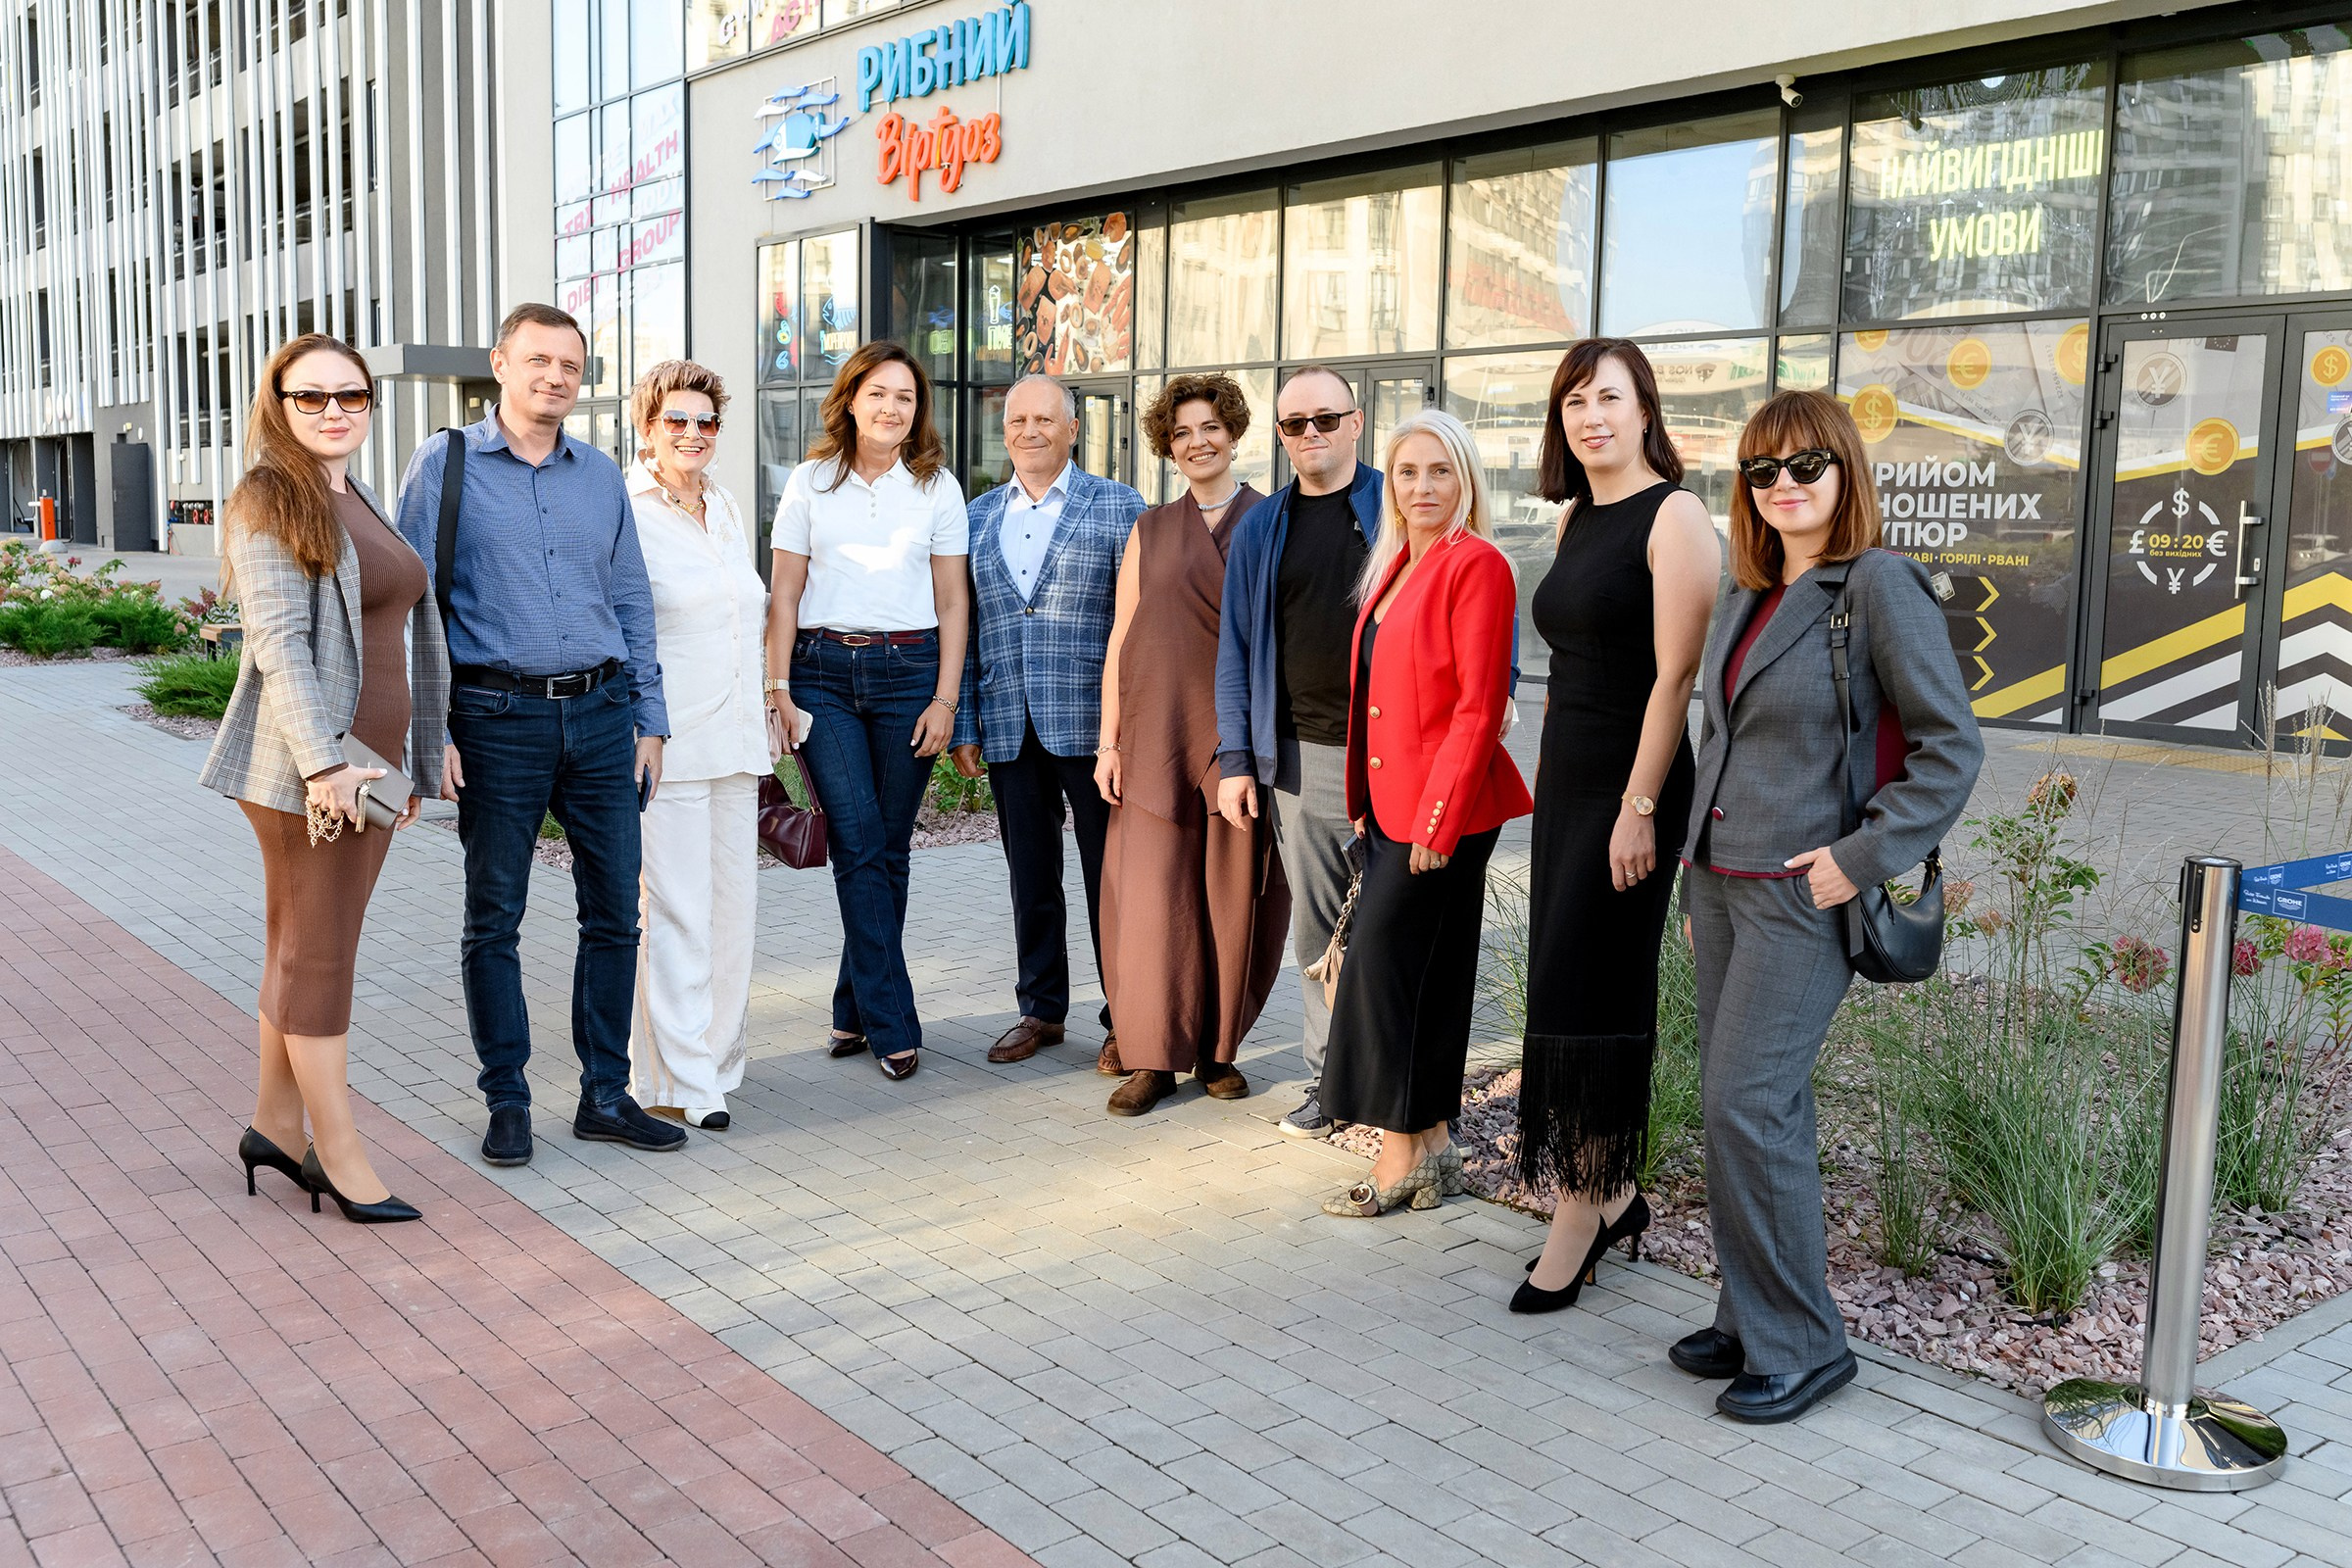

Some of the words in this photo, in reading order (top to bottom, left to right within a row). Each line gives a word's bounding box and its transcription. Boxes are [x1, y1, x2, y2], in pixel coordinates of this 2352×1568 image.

[858, 0, 1031, 113] РИБНИЙ
[611, 129, 677, 205] HEALTH
[1880, 129, 2104, 200] НАЙВИГІДНІШІ
[1930, 206, 2042, 262] УМОВИ
[567, 270, 601, 315] DIET
[616, 208, 683, 274] GROUP
[1870, 455, 1996, 488] РИЙОМ
[1878, 493, 2042, 519] НОШЕНИХ
[1882, 521, 1968, 548] ПЮР
[1939, 553, 1981, 564] ГОРІЛІ
[1987, 554, 2030, 566] РВАНІ
[2165, 549, 2202, 558] вихідних
[2277, 896, 2303, 906] GROHE
